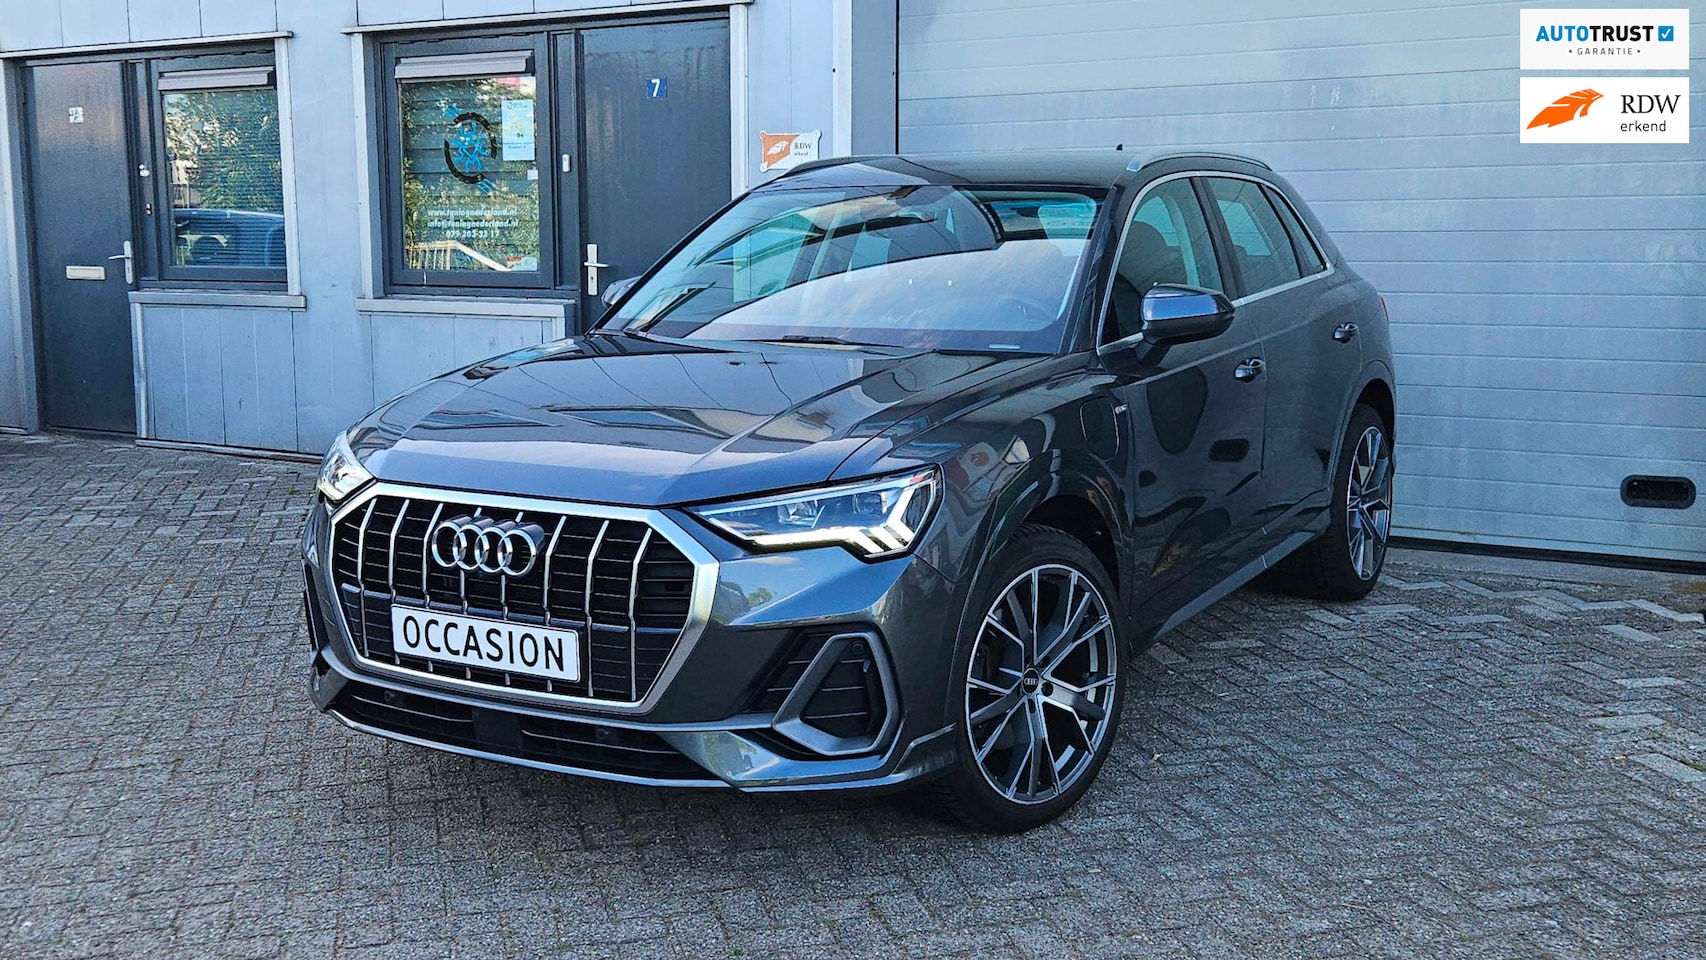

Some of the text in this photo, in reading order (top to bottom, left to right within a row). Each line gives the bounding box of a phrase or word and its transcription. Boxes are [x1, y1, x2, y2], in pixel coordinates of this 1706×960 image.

[651, 79, 661, 98] 7
[794, 142, 812, 150] RDW
[403, 615, 564, 672] OCCASION
